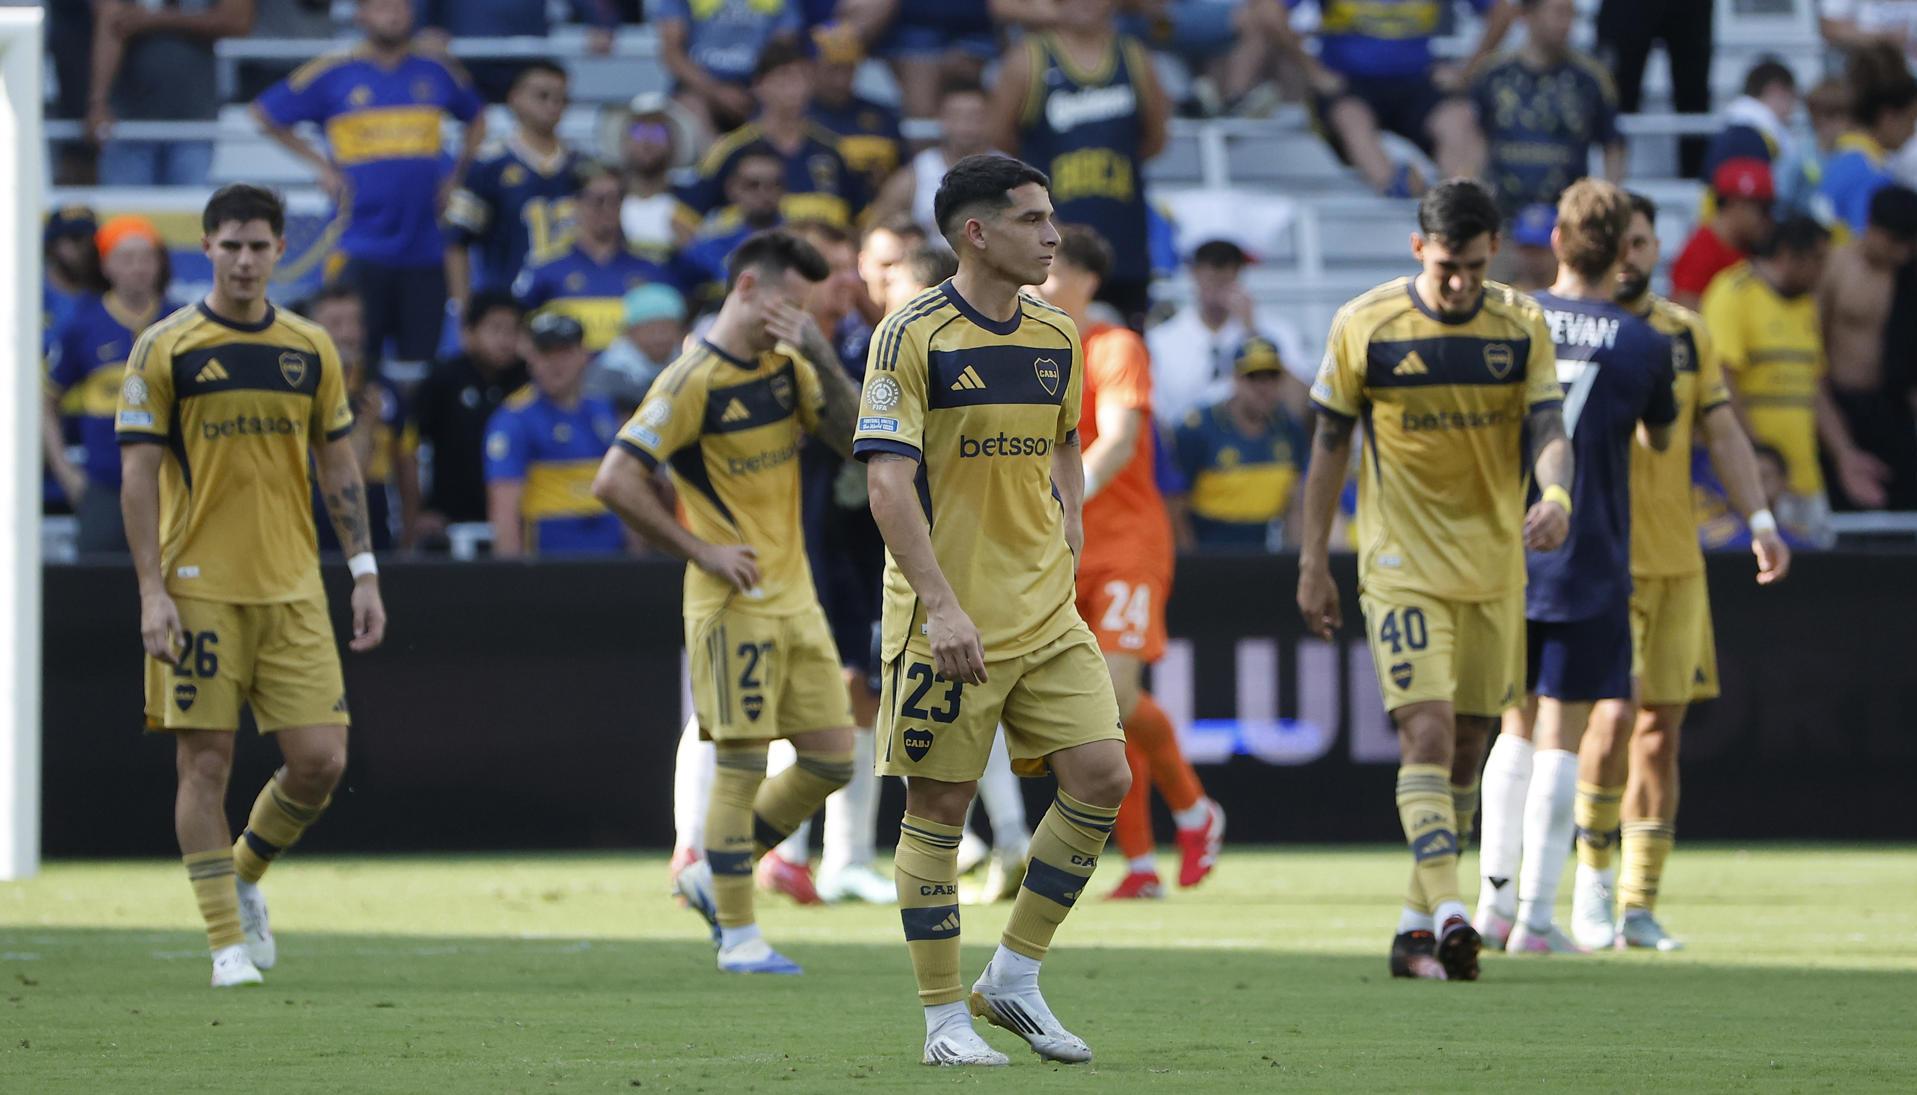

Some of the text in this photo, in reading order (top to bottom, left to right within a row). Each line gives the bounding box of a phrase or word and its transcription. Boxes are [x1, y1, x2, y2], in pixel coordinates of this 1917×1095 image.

[1039, 369, 1058, 378] CABJ
[1555, 359, 1600, 439] 7
[1101, 580, 1151, 633] 24
[1381, 607, 1427, 653] 40
[174, 631, 219, 679] 26
[901, 662, 963, 723] 23
[905, 738, 930, 748] CABJ
[1071, 854, 1098, 867] CA
